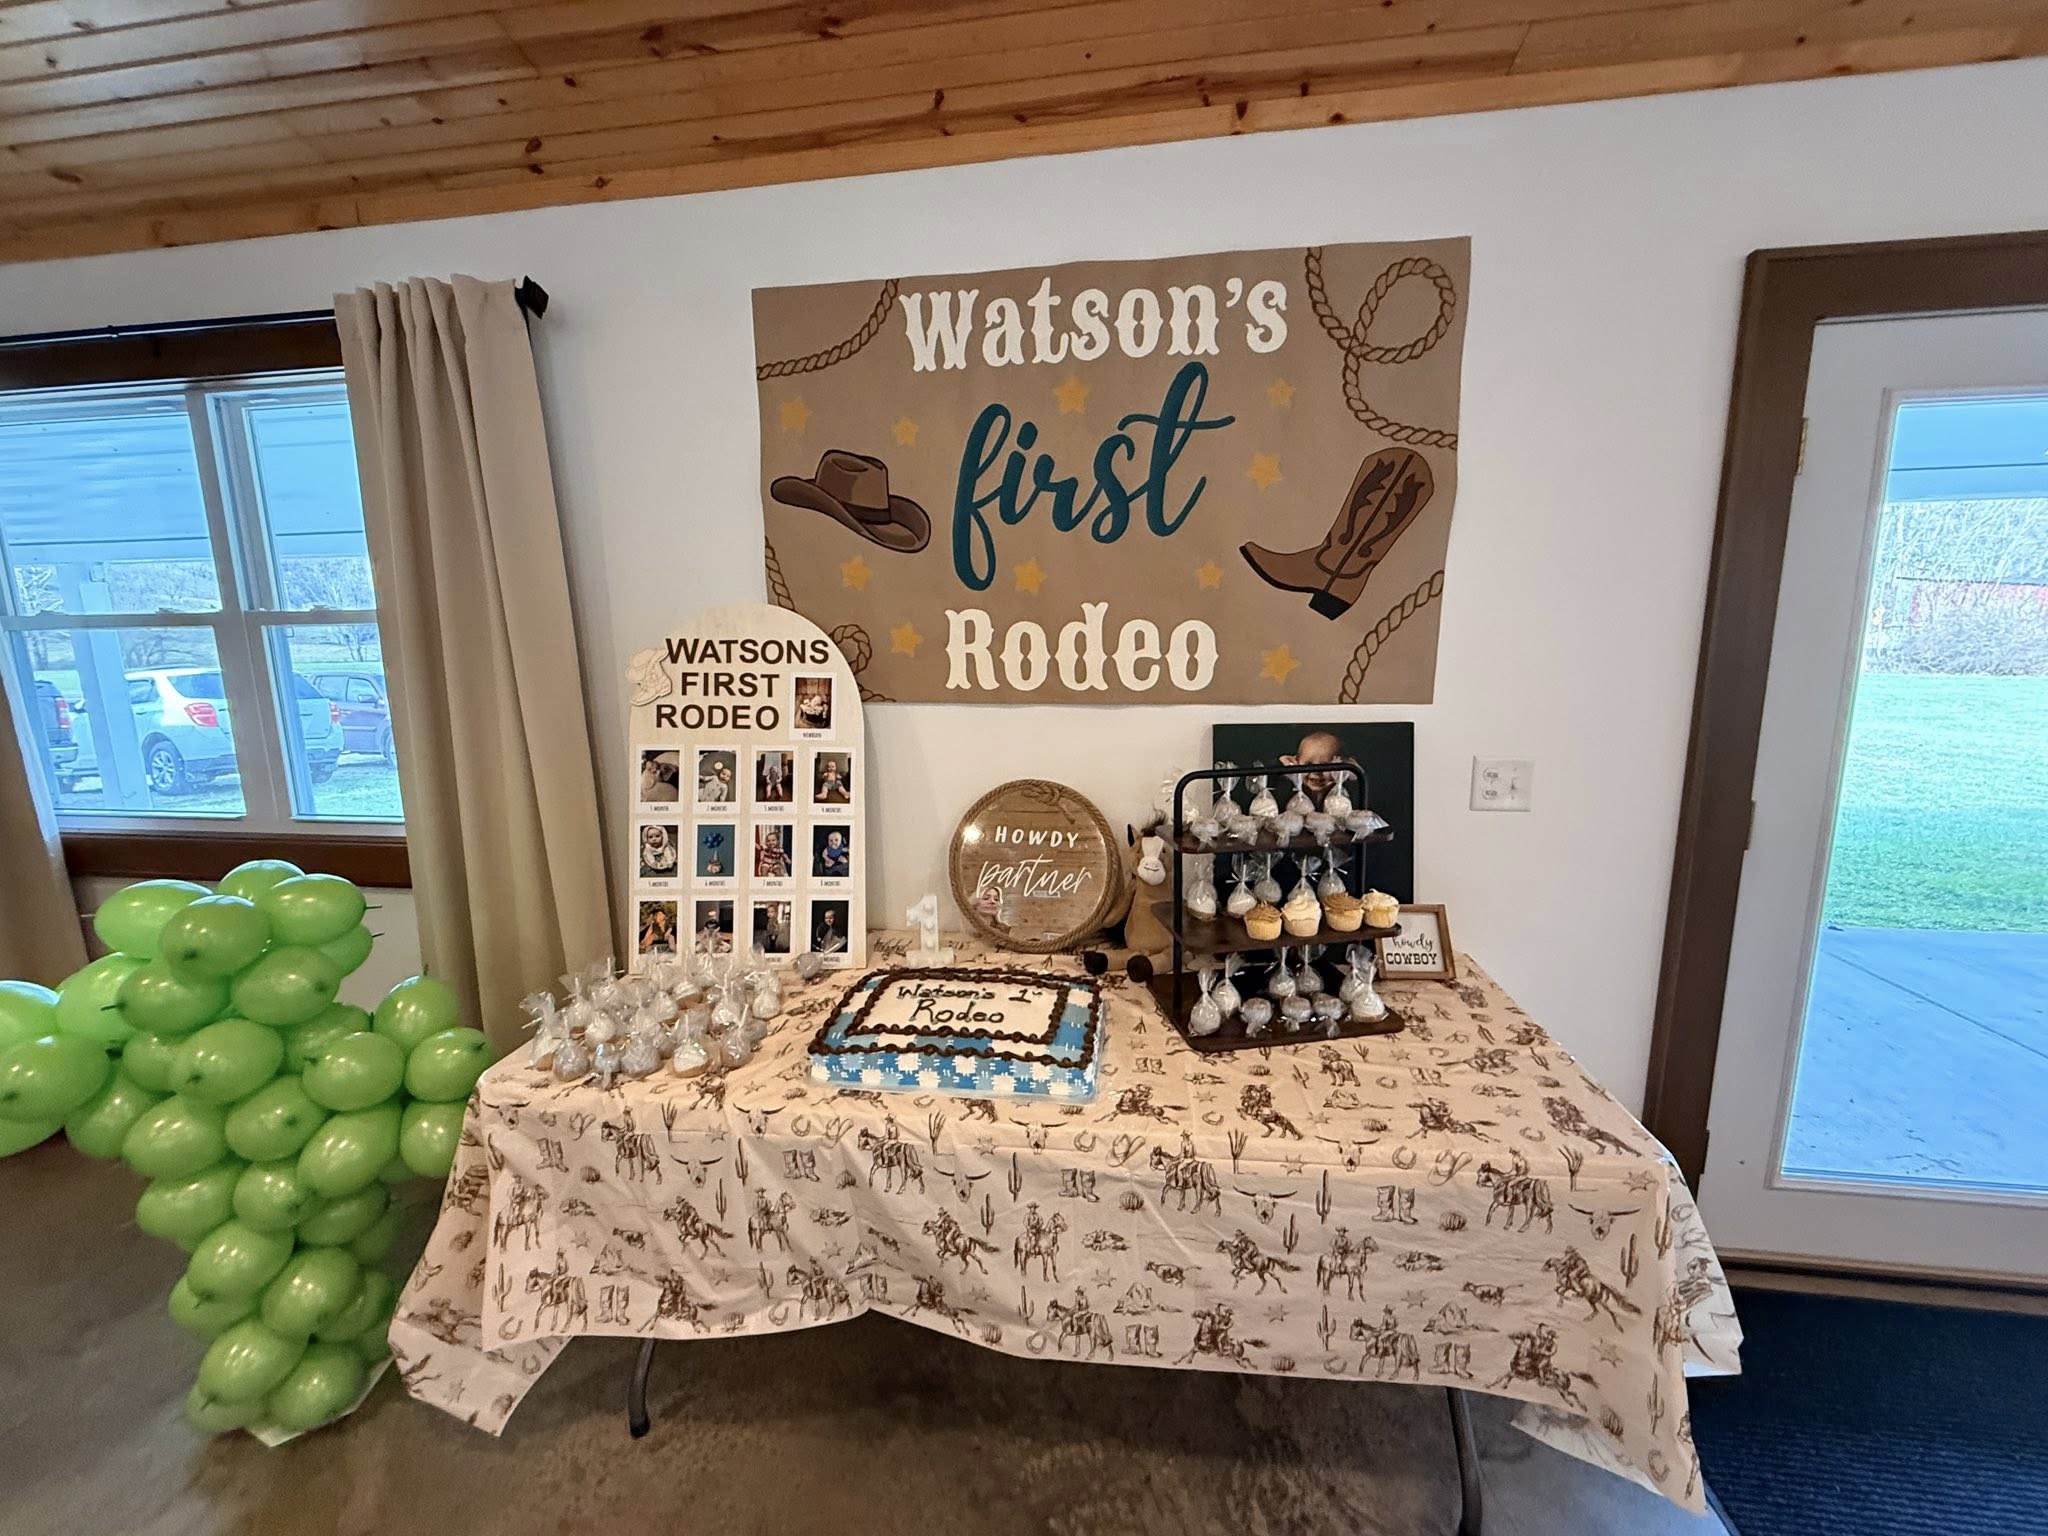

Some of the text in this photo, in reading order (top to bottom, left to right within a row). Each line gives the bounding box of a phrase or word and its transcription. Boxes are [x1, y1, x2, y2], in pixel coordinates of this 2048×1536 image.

[900, 277, 1288, 372] Watson's
[952, 361, 1236, 591] first
[665, 638, 830, 665] WATSONS
[945, 602, 1220, 692] Rodeo
[681, 671, 780, 698] FIRST
[655, 704, 780, 731] RODEO
[994, 825, 1079, 849] HOWDY
[976, 853, 1093, 899] partner
[1393, 933, 1433, 952] howdy
[1385, 952, 1437, 965] COWBOY
[909, 998, 1005, 1025] Rodeo
